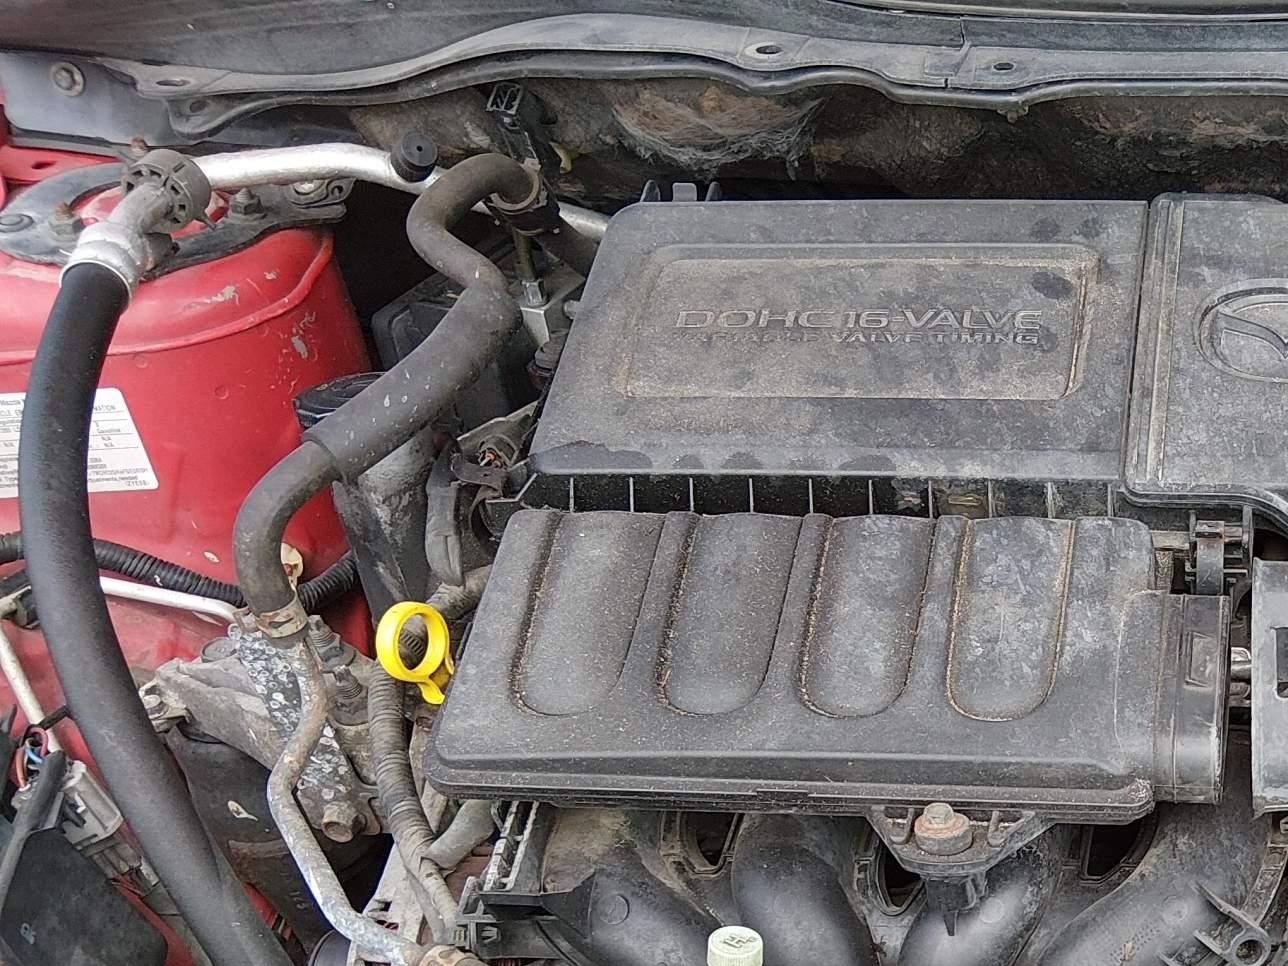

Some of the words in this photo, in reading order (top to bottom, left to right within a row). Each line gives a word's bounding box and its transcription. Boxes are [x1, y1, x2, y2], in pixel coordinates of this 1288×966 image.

[675, 310, 835, 329] DOHC
[848, 308, 1043, 331] 16-VALVE
[832, 332, 922, 344] VALVE
[935, 332, 1040, 345] TIMING
